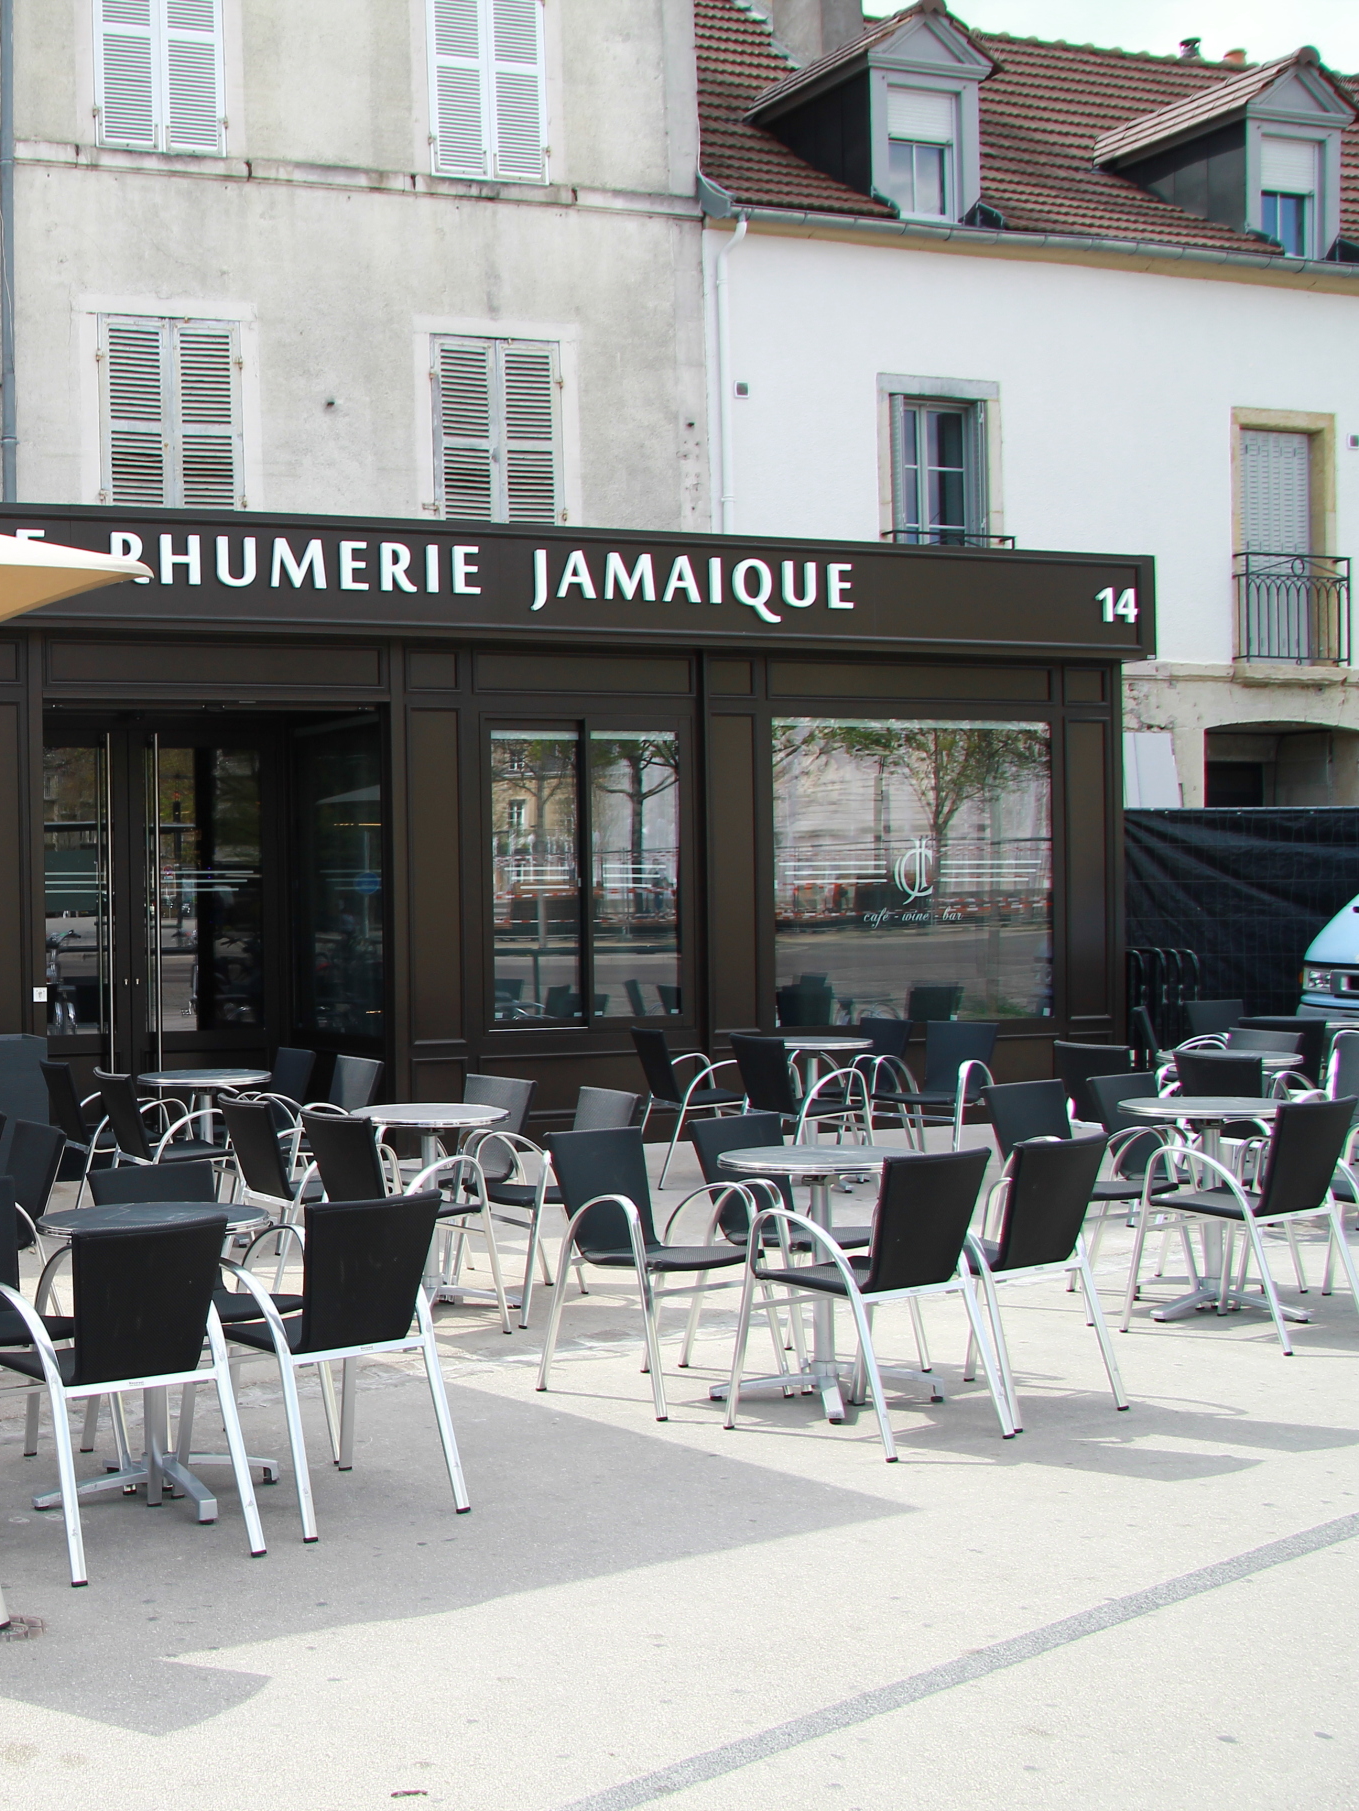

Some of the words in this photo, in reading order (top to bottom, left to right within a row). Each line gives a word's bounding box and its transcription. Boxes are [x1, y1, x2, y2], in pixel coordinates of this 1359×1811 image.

[108, 531, 483, 595] RHUMERIE
[529, 548, 855, 624] JAMAIQUE
[1095, 586, 1139, 624] 14
[902, 910, 929, 921] wine
[942, 906, 962, 920] bar
